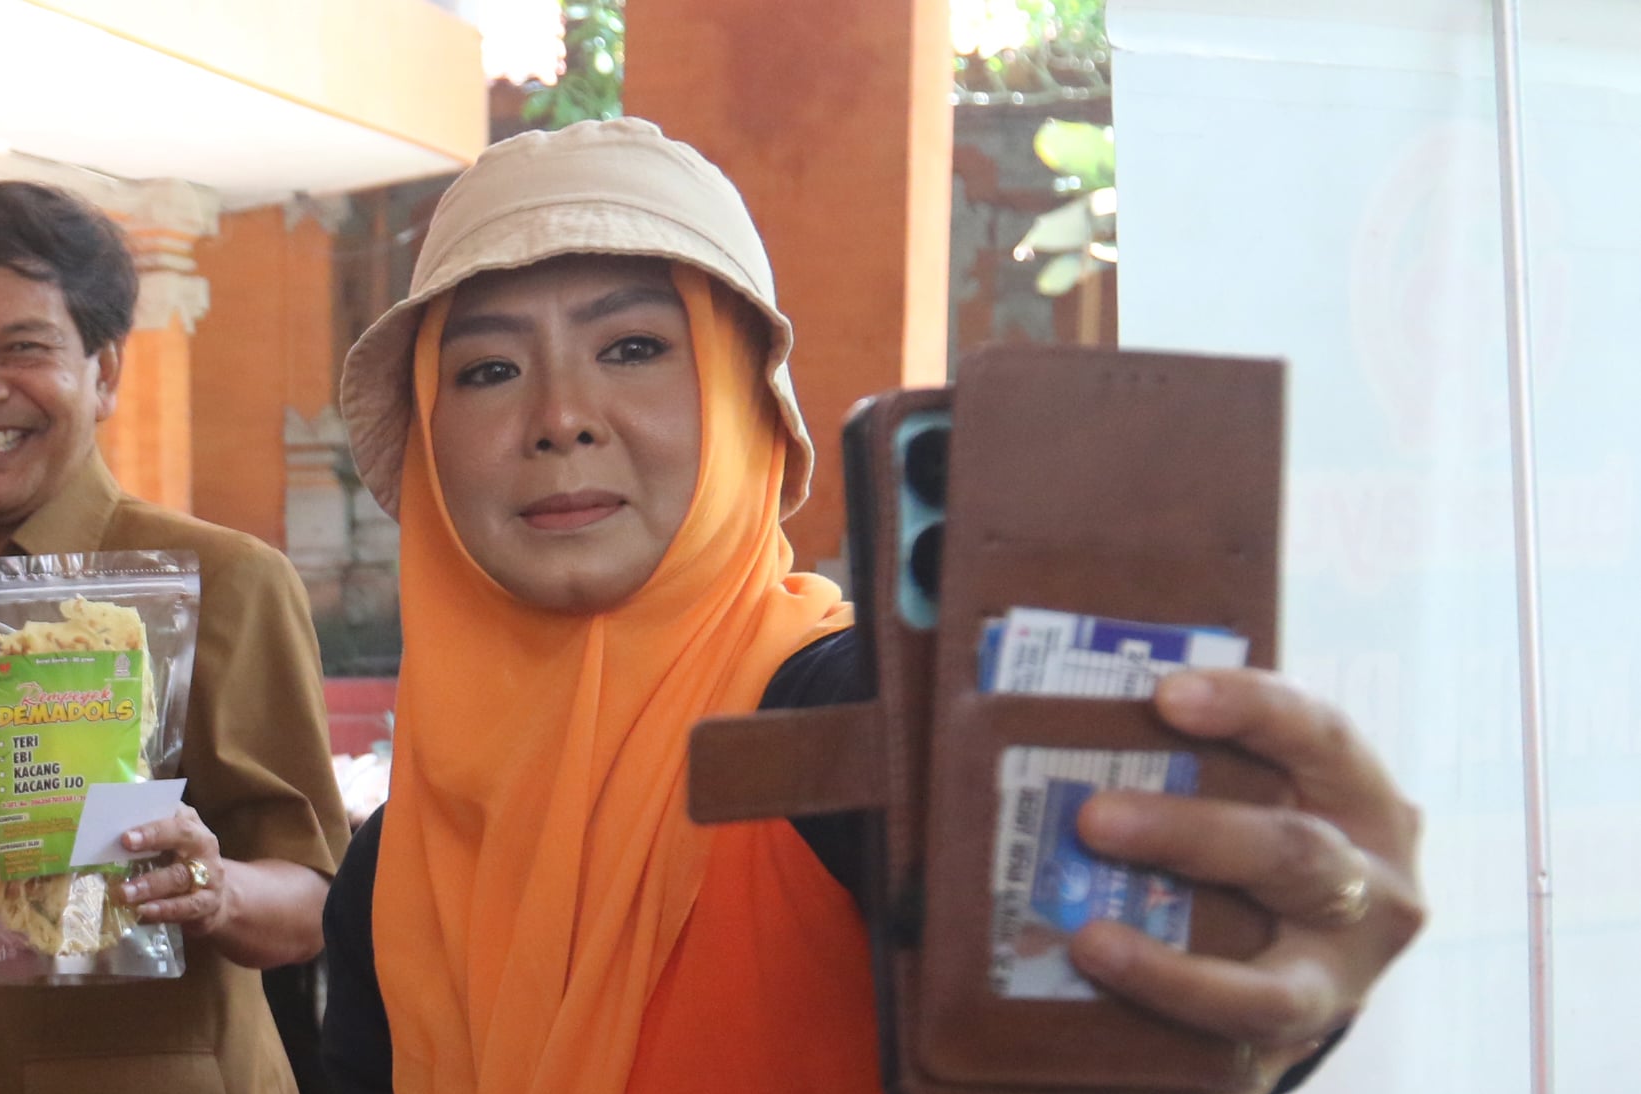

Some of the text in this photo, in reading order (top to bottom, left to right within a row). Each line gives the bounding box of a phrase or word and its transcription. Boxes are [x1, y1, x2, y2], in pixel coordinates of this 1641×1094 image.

[13, 735, 39, 749] TERI
[13, 751, 32, 764] EBI
[14, 762, 61, 779] KACANG
[14, 776, 84, 795] KACANG IJO
